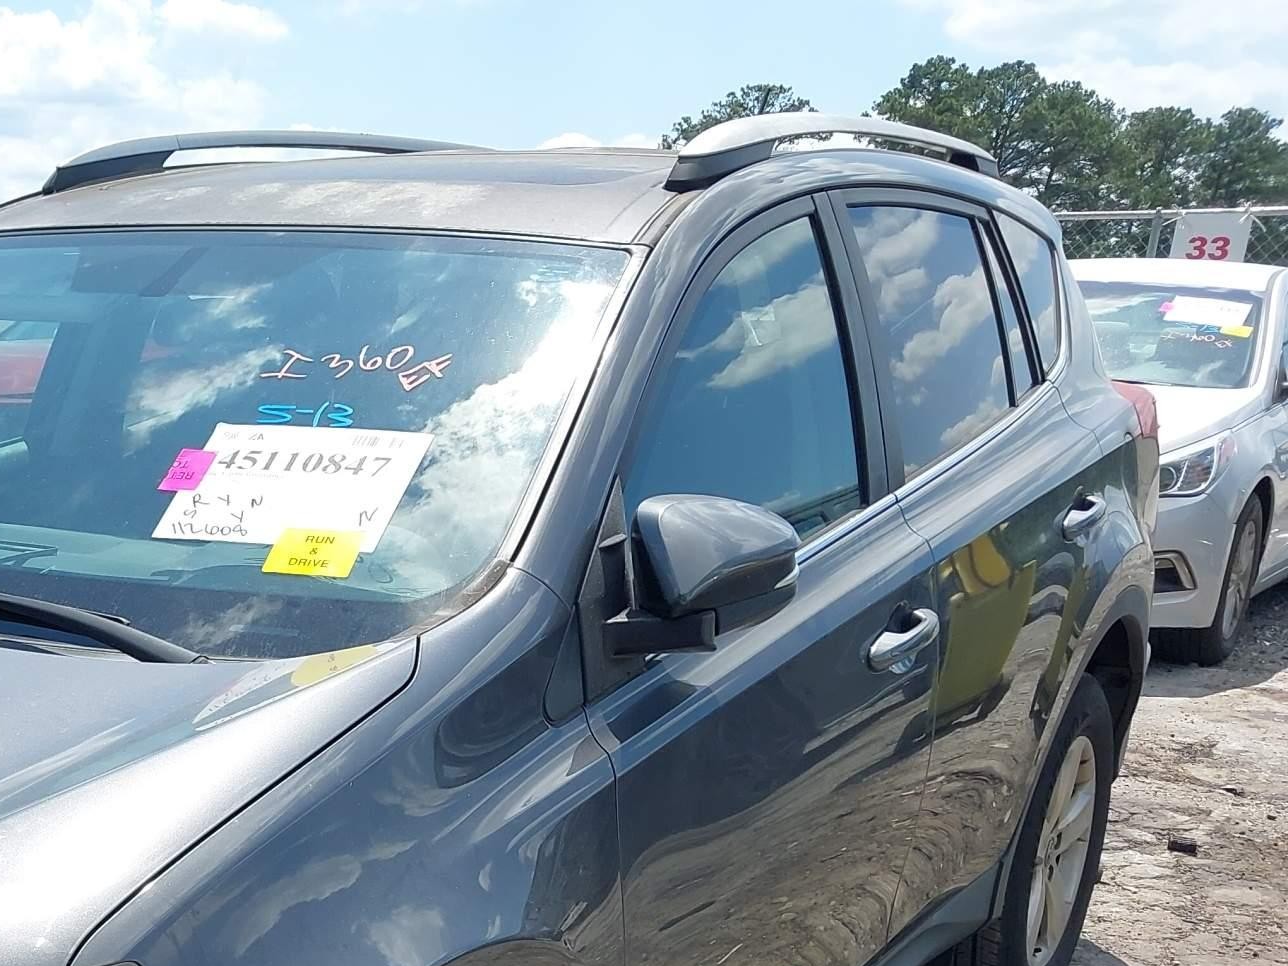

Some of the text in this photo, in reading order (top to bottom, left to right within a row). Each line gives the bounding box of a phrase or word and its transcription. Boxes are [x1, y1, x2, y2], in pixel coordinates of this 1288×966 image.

[1185, 236, 1231, 260] 33
[320, 344, 414, 379] 360
[217, 449, 393, 478] 45110847
[305, 535, 335, 544] RUN
[309, 547, 318, 555] &
[288, 557, 329, 568] DRIVE
